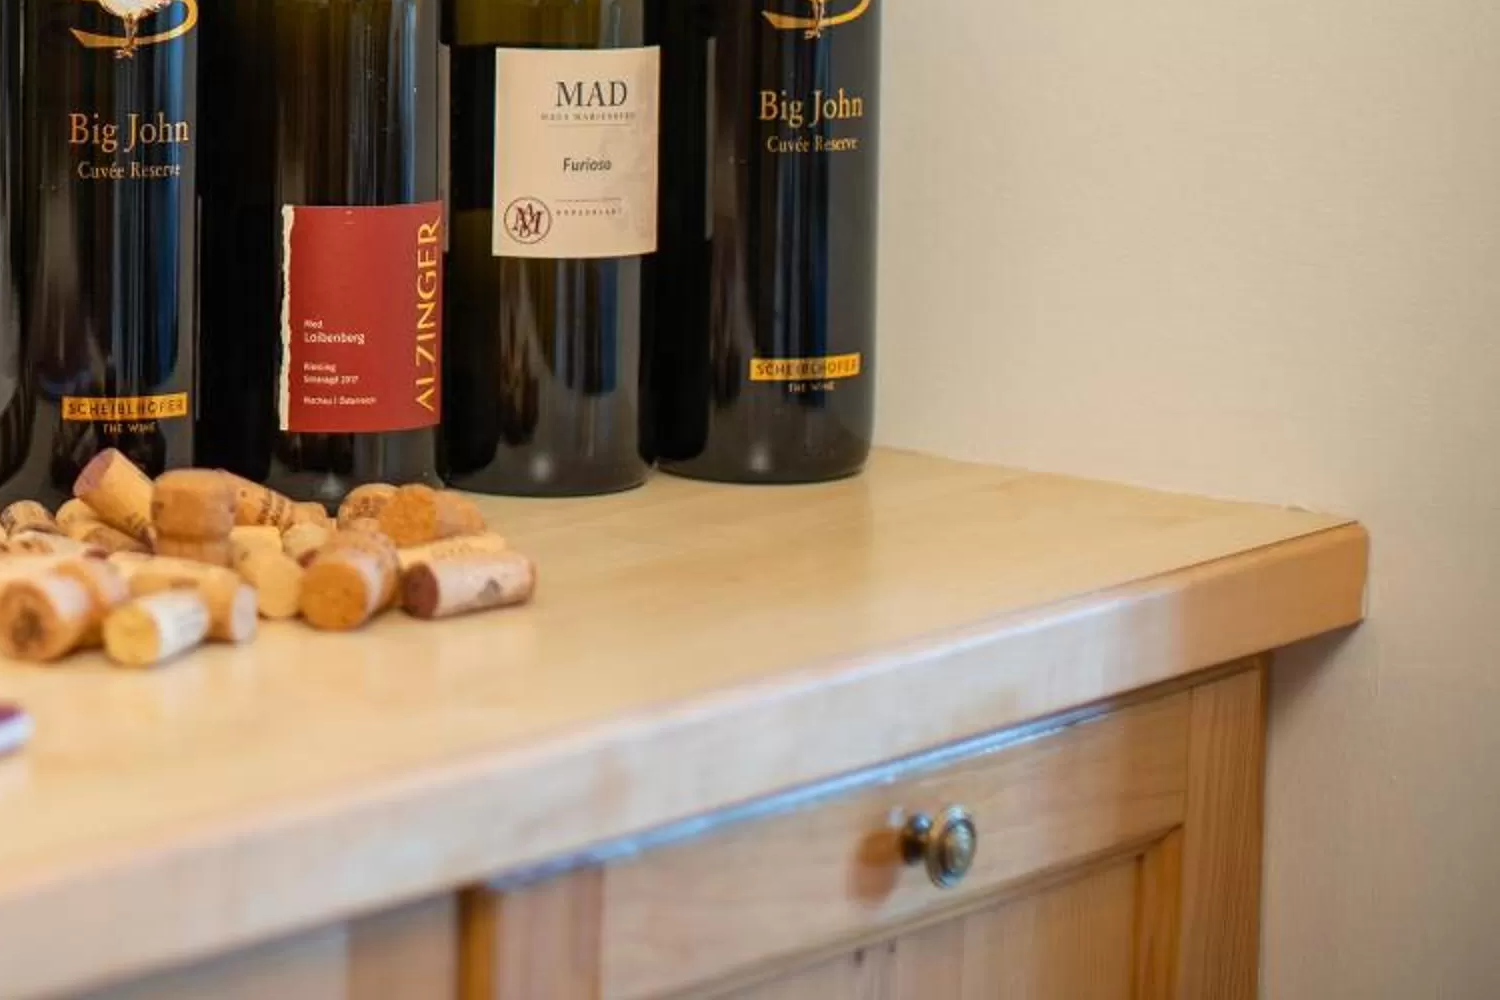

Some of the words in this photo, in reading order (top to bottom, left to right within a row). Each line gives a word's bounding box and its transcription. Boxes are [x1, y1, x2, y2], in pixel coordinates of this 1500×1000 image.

[555, 80, 628, 107] MAD
[759, 89, 804, 128] Big
[809, 87, 863, 128] John
[68, 112, 119, 153] Big
[123, 111, 189, 153] John
[767, 135, 809, 152] Cuvée
[814, 135, 859, 151] Reserve
[77, 160, 125, 179] Cuvée
[130, 161, 181, 179] Reserve
[563, 156, 612, 172] Furioso
[415, 215, 441, 412] ALZINGER
[103, 422, 123, 433] THE
